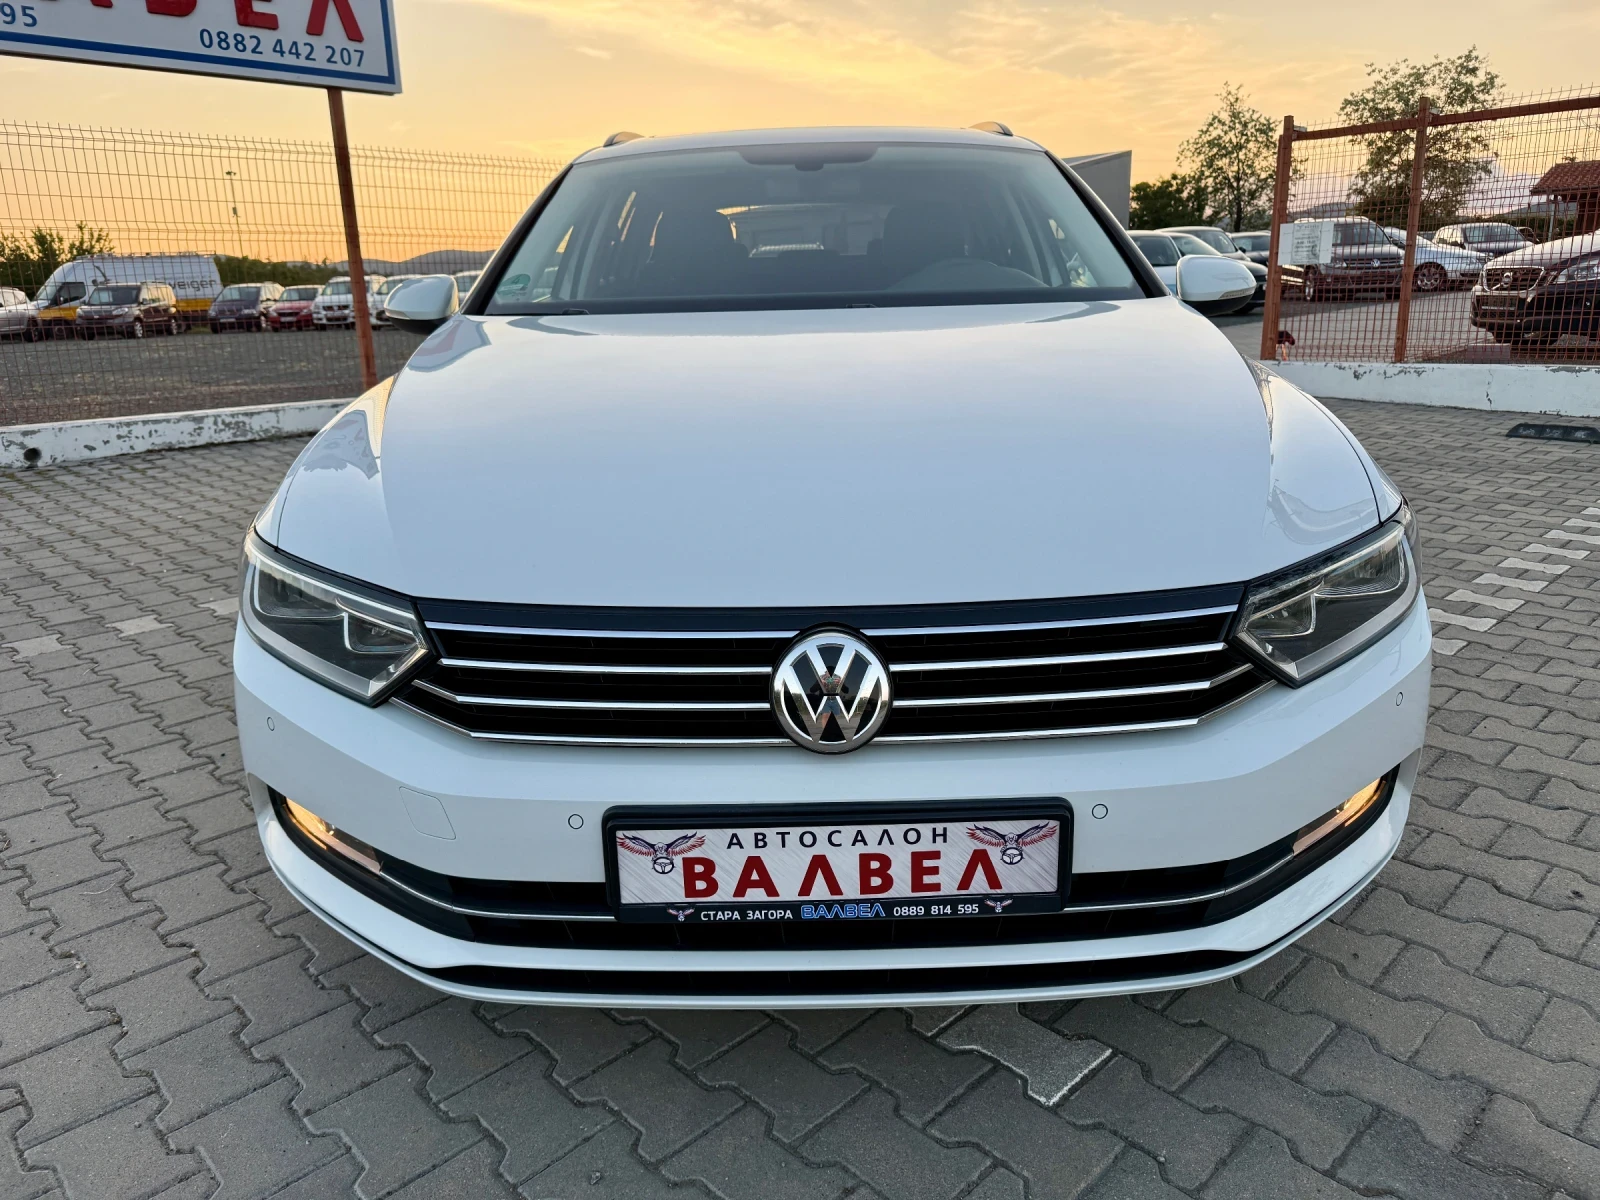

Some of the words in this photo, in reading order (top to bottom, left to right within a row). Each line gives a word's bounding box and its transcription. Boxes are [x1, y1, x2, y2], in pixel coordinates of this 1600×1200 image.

[0, 2, 38, 28] 95
[199, 28, 264, 55] 0882
[272, 38, 317, 62] 442
[325, 45, 365, 67] 207
[726, 826, 948, 850] АВТОСАЛОН
[682, 848, 1003, 899] ВАЛВЕЛ
[700, 910, 741, 921] СТАРА
[746, 909, 794, 920] ЗАГОРА
[800, 902, 886, 920] ВАЛВЕЛ
[893, 905, 925, 917] 0889
[930, 904, 952, 915] 814
[957, 903, 979, 914] 595
